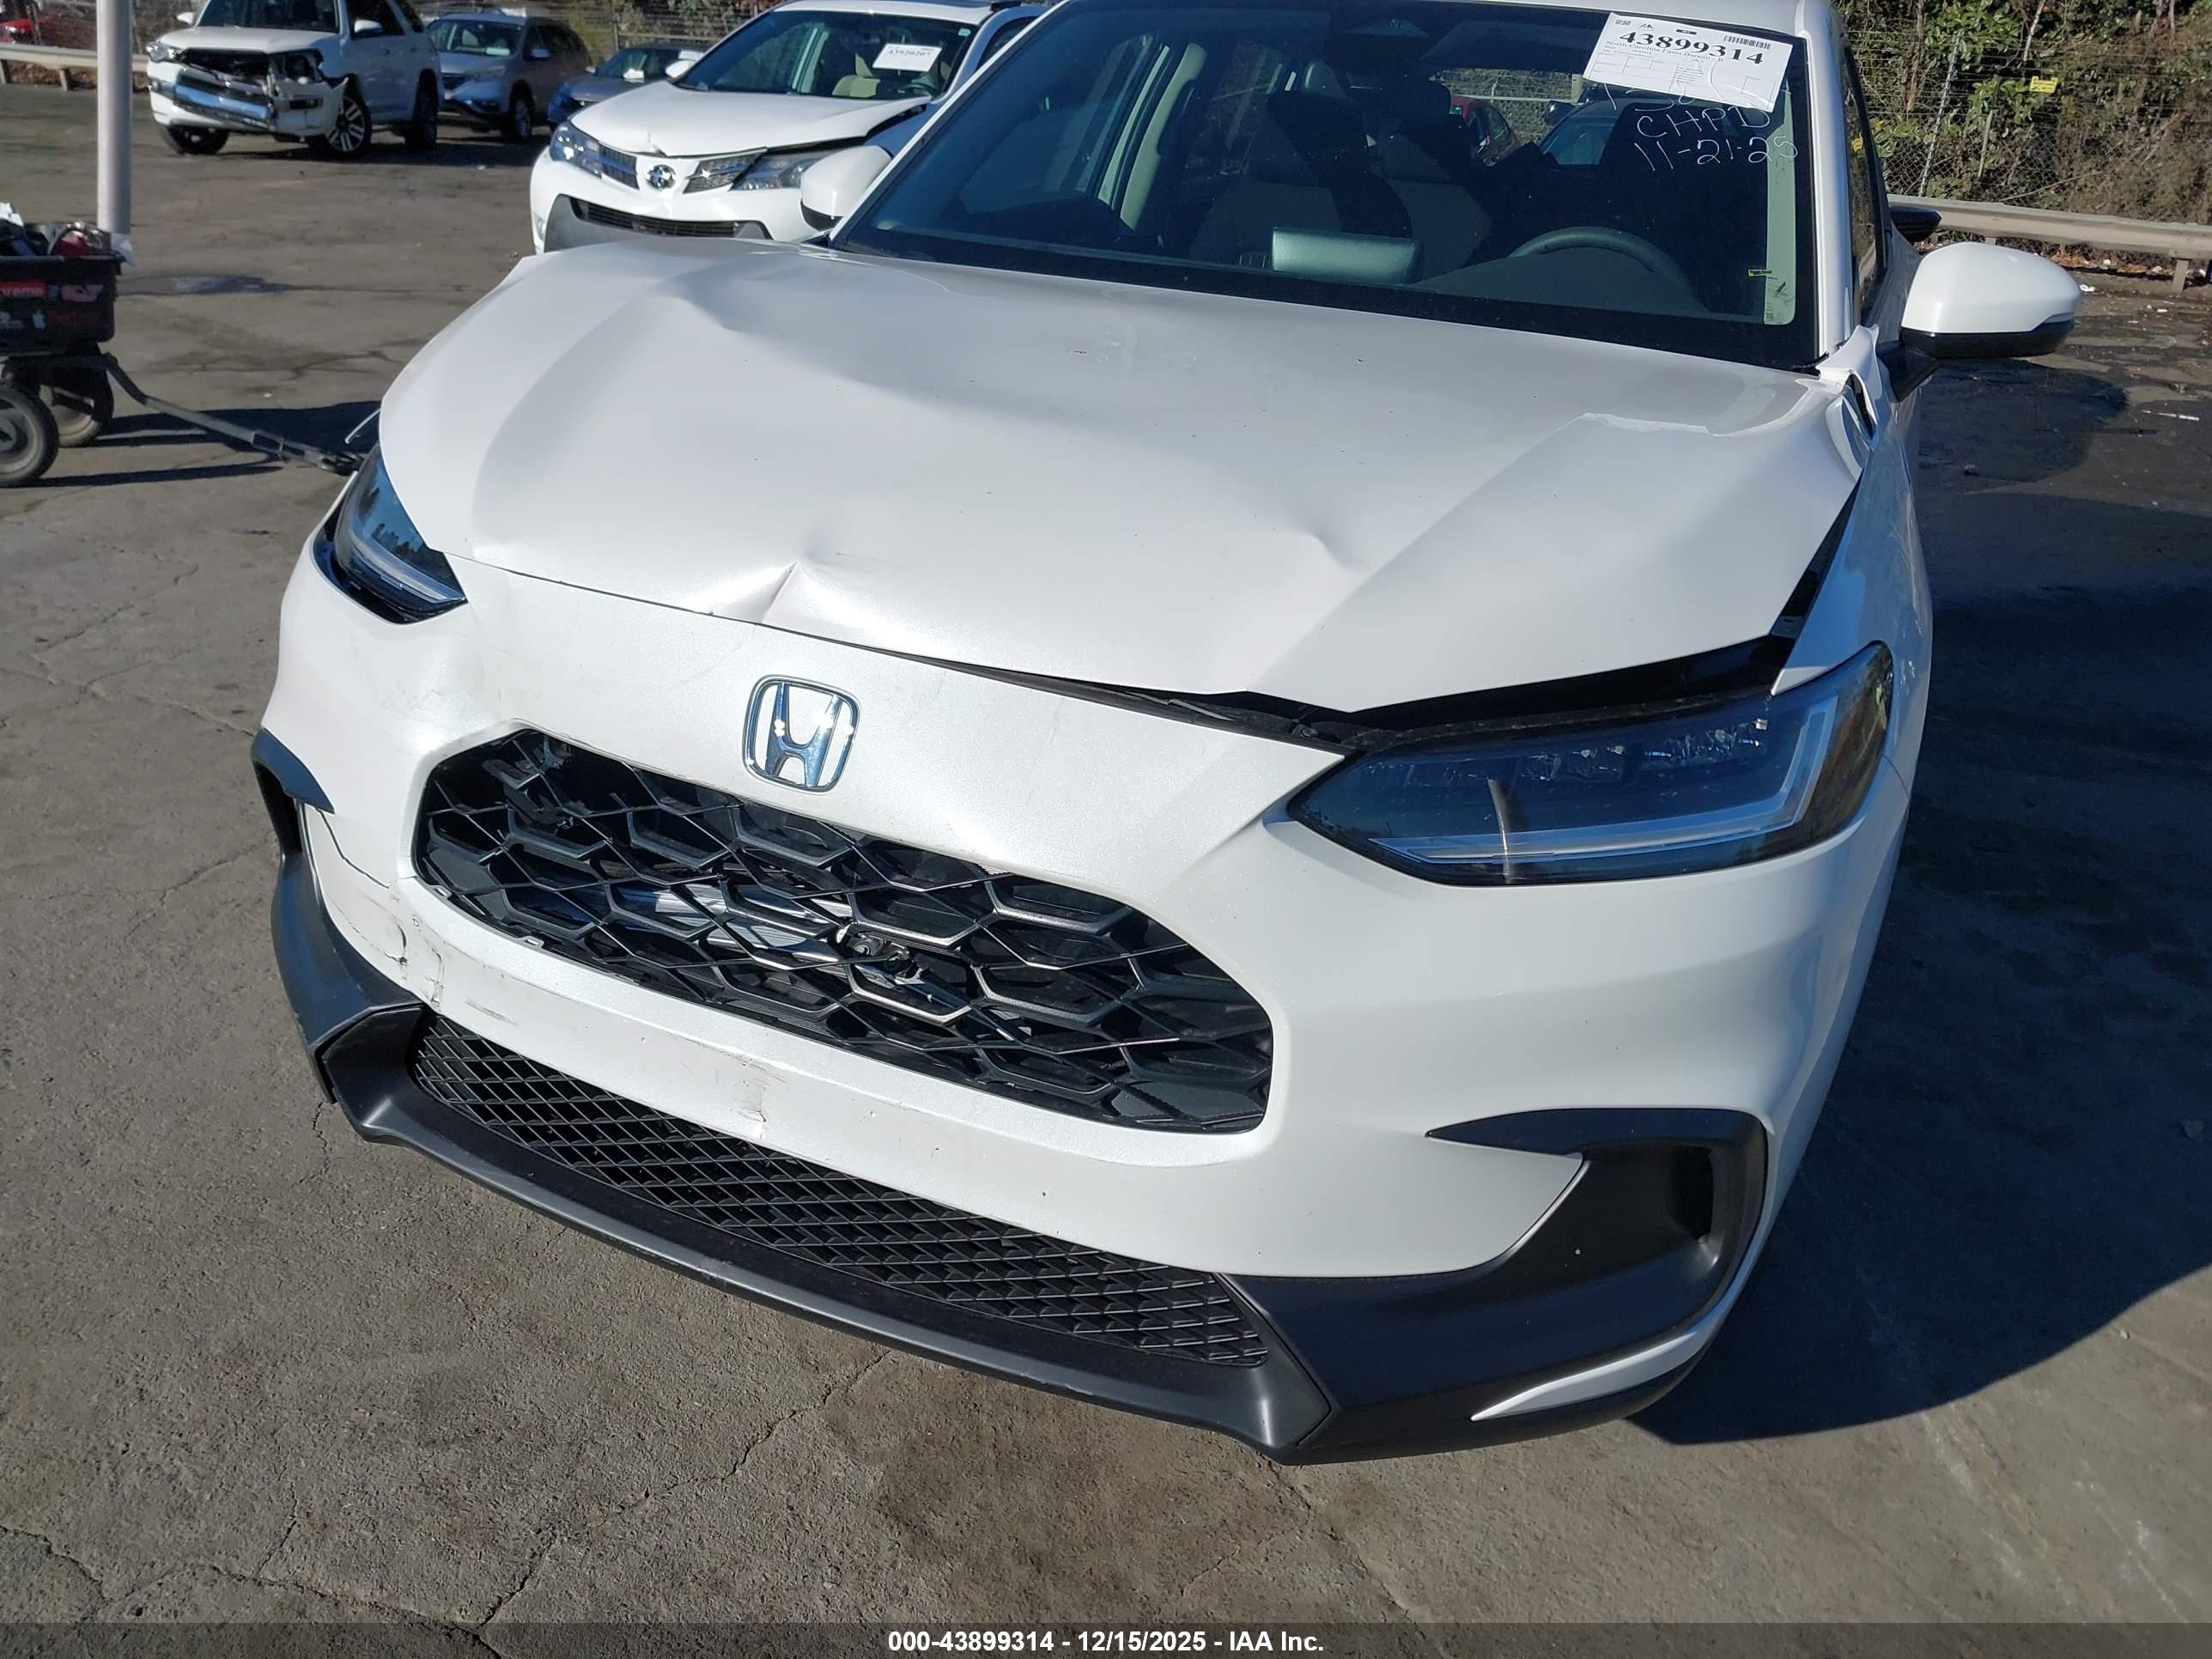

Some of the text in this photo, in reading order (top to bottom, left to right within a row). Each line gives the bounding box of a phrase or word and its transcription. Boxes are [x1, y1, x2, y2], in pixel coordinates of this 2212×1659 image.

[1619, 31, 1764, 64] 43899314
[1629, 43, 1661, 52] Carolina
[1634, 136, 1798, 172] 11-21-25
